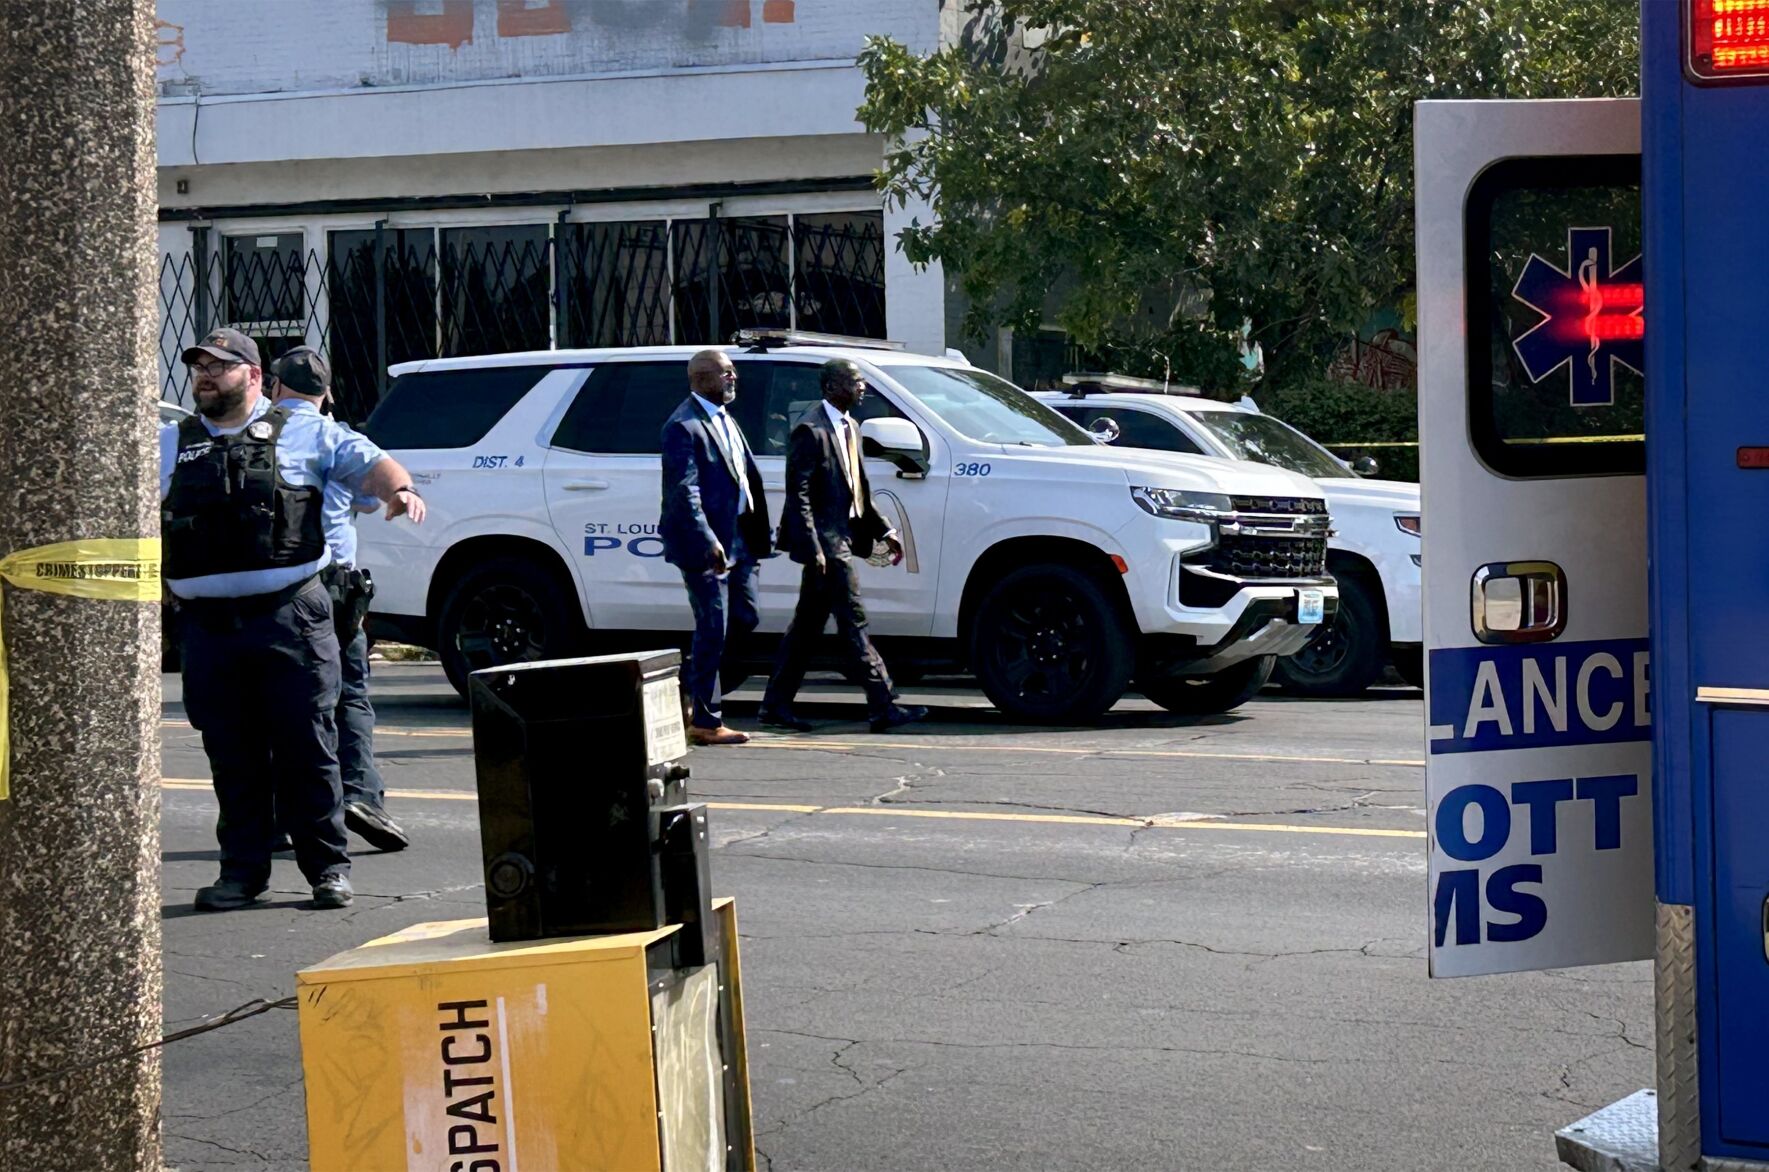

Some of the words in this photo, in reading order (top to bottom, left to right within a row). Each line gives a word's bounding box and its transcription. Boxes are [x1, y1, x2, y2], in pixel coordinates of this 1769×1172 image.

[472, 456, 508, 469] DIST.
[514, 456, 525, 468] 4
[954, 462, 991, 477] 380
[584, 523, 611, 535] ST.
[1435, 774, 1638, 862] OTT
